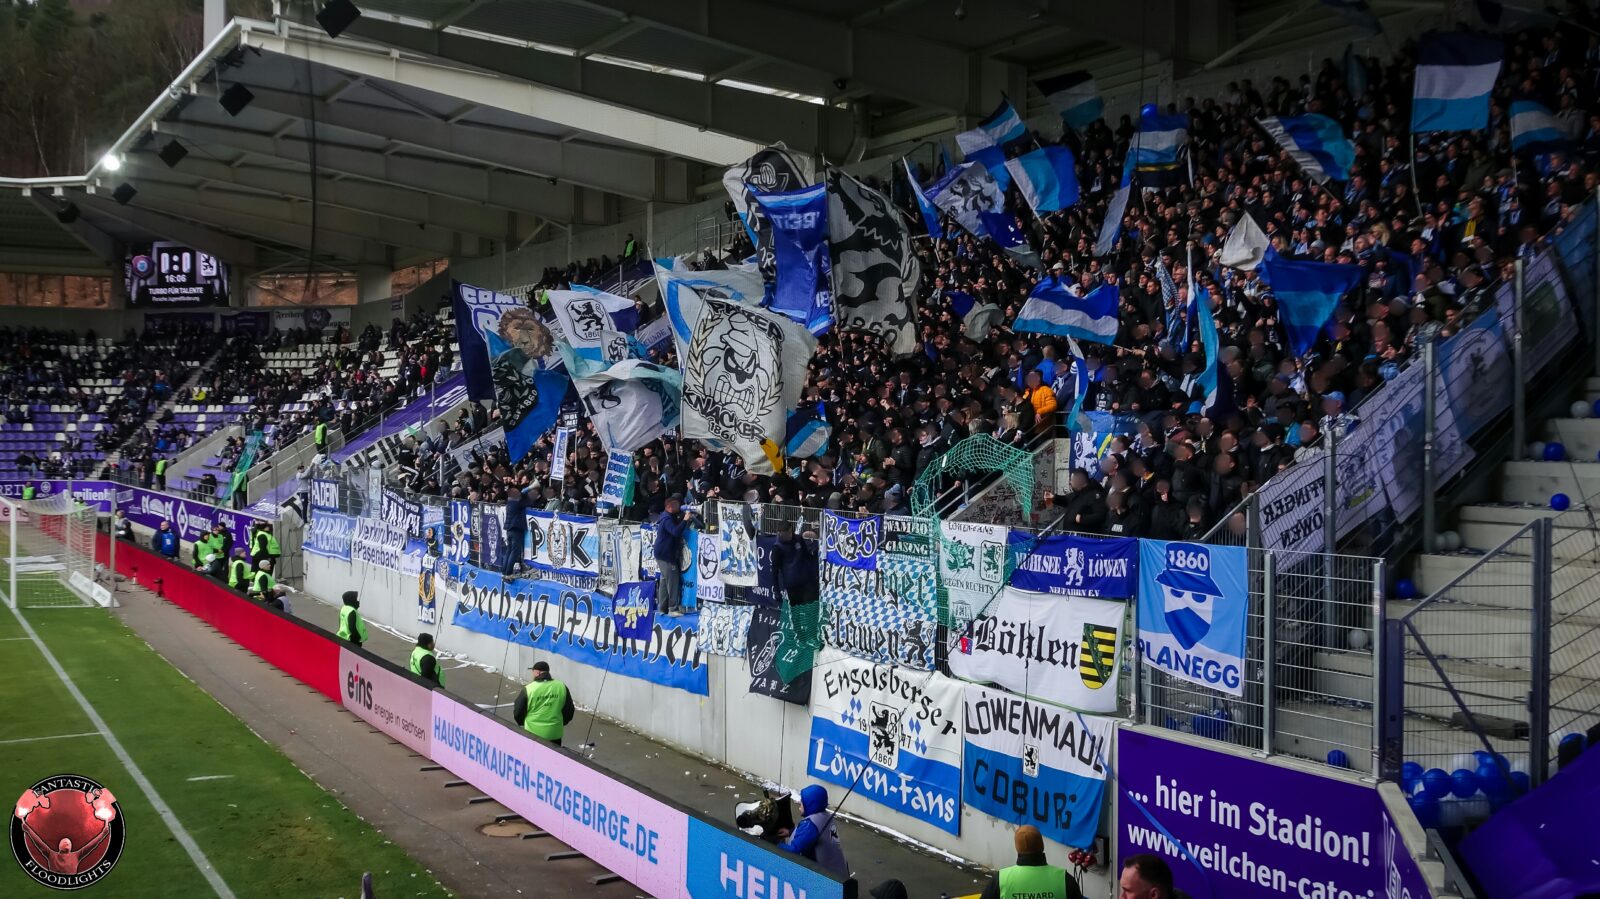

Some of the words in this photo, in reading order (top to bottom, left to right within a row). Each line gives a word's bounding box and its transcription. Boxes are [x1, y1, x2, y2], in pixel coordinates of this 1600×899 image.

[161, 252, 191, 273] 1:1
[164, 275, 187, 283] 16:06
[149, 287, 167, 295] TURBO
[168, 286, 179, 294] FÜR
[682, 382, 767, 444] KNACKER
[708, 419, 737, 444] 1860
[530, 517, 545, 559] P
[570, 525, 594, 568] K
[1169, 550, 1209, 570] 1860
[1088, 554, 1128, 578] LÖWEN
[459, 570, 550, 642] Sechzig
[965, 581, 994, 595] RECHTS
[1049, 586, 1087, 597] NEUFAHRN
[975, 612, 1077, 672] Böhlen
[1138, 637, 1240, 689] PLANEGG
[347, 664, 373, 711] eins
[374, 703, 394, 725] energie
[401, 717, 426, 742] sachsen
[874, 752, 893, 768] 1860
[433, 714, 660, 864] HAUSVERKAUFEN-ERZGEBIRGE.DE
[815, 738, 955, 823] Löwen-Fans
[1155, 775, 1204, 818] hier
[1210, 789, 1241, 829] im
[1248, 801, 1371, 867] Stadion!
[1127, 823, 1373, 899] www.veilchen-cat
[1012, 891, 1055, 899] STEWARD
